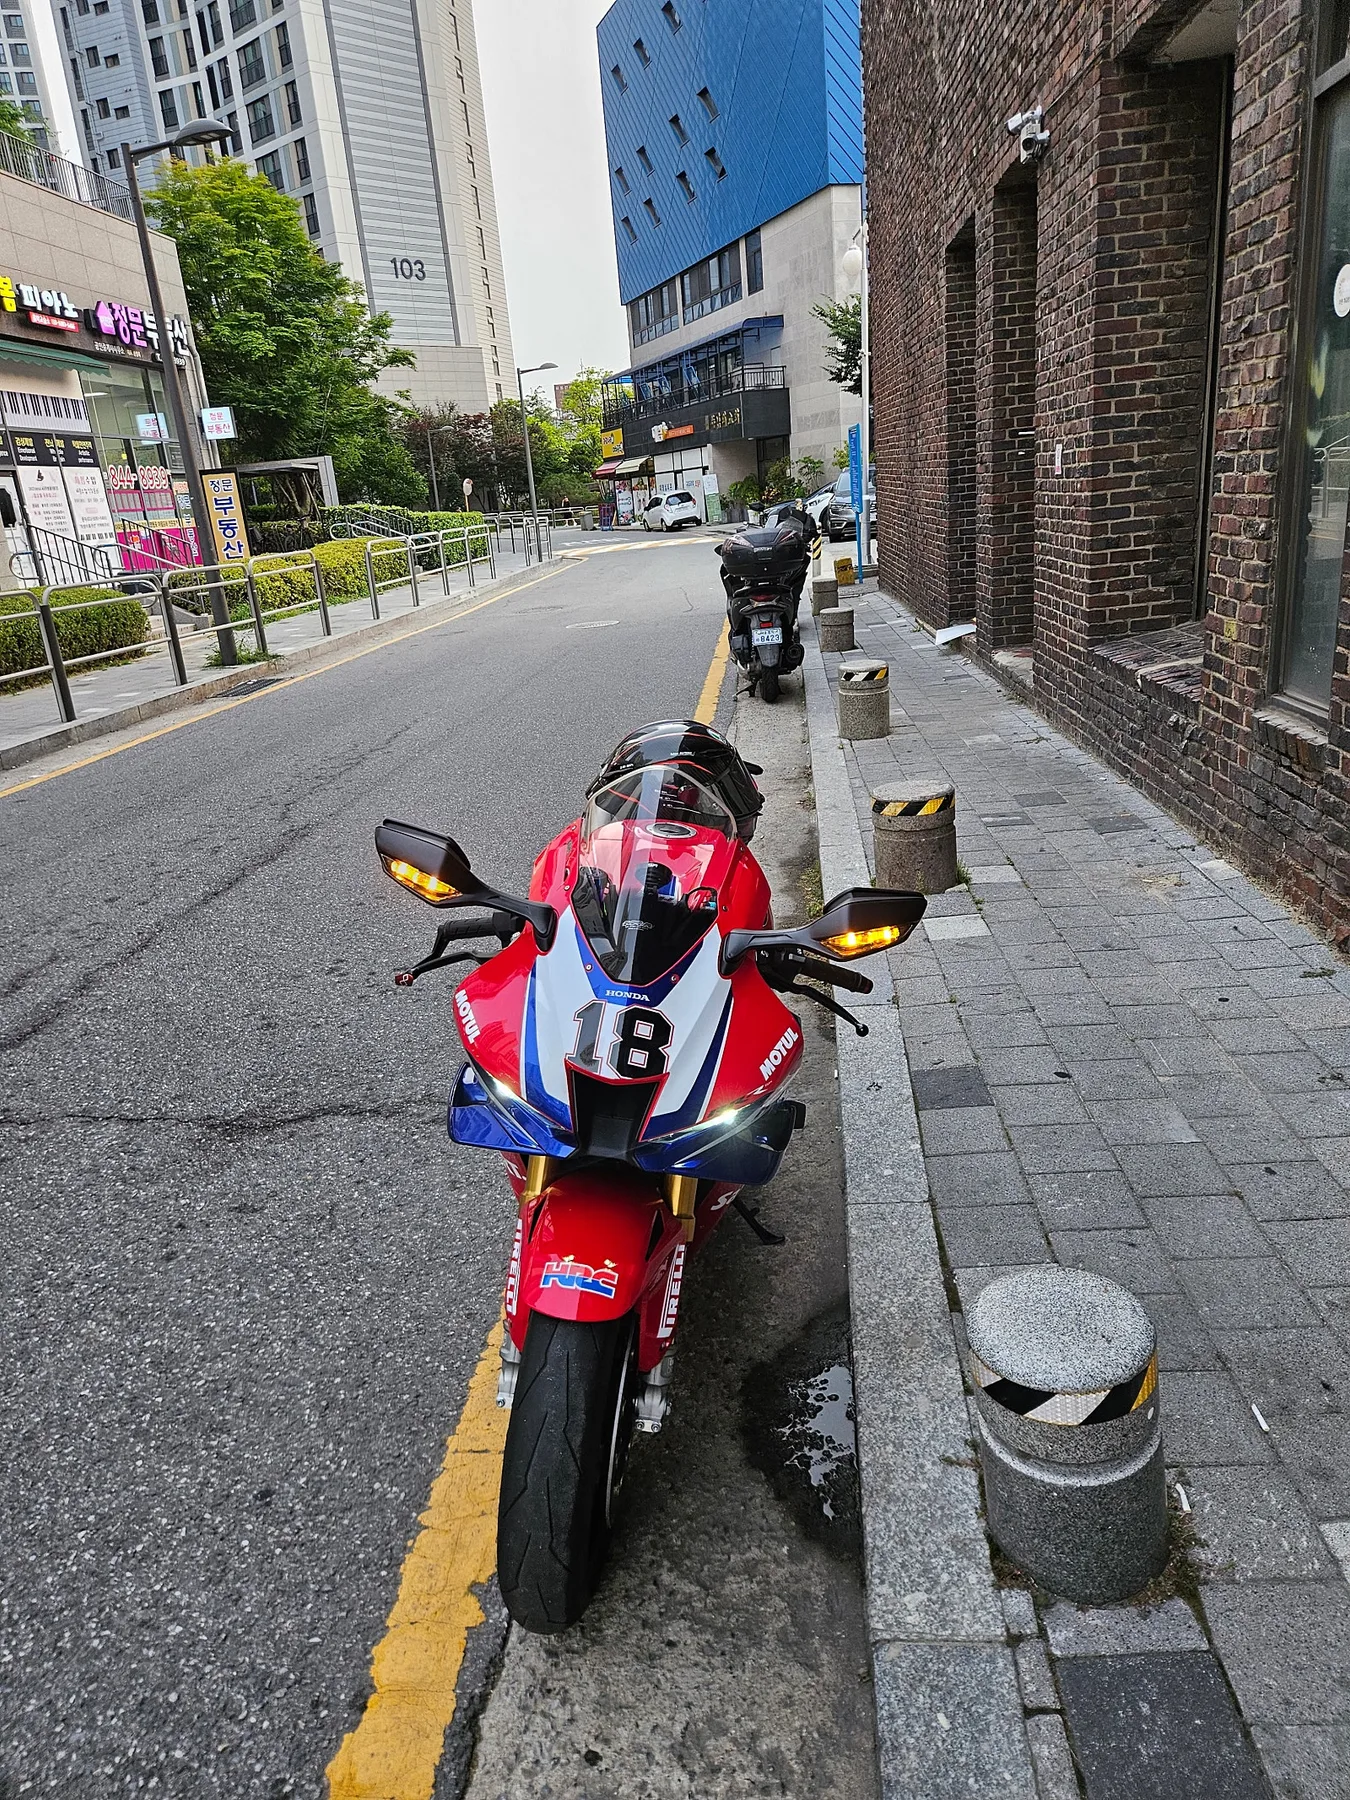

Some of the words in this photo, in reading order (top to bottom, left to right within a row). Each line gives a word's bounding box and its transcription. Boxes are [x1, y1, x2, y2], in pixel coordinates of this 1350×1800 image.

[390, 257, 426, 281] 103
[18, 284, 79, 318] 피아노
[207, 423, 231, 434] 부동산
[209, 411, 224, 421] 정문
[108, 463, 169, 490] 844-8939
[209, 478, 233, 493] 정문
[212, 495, 244, 560] 부동산
[760, 633, 780, 643] 8423
[605, 989, 651, 1002] HONDA
[455, 988, 481, 1044] MOTUL
[564, 999, 675, 1080] 18
[759, 1026, 799, 1082] MOTUL
[539, 1260, 618, 1300] HRC
